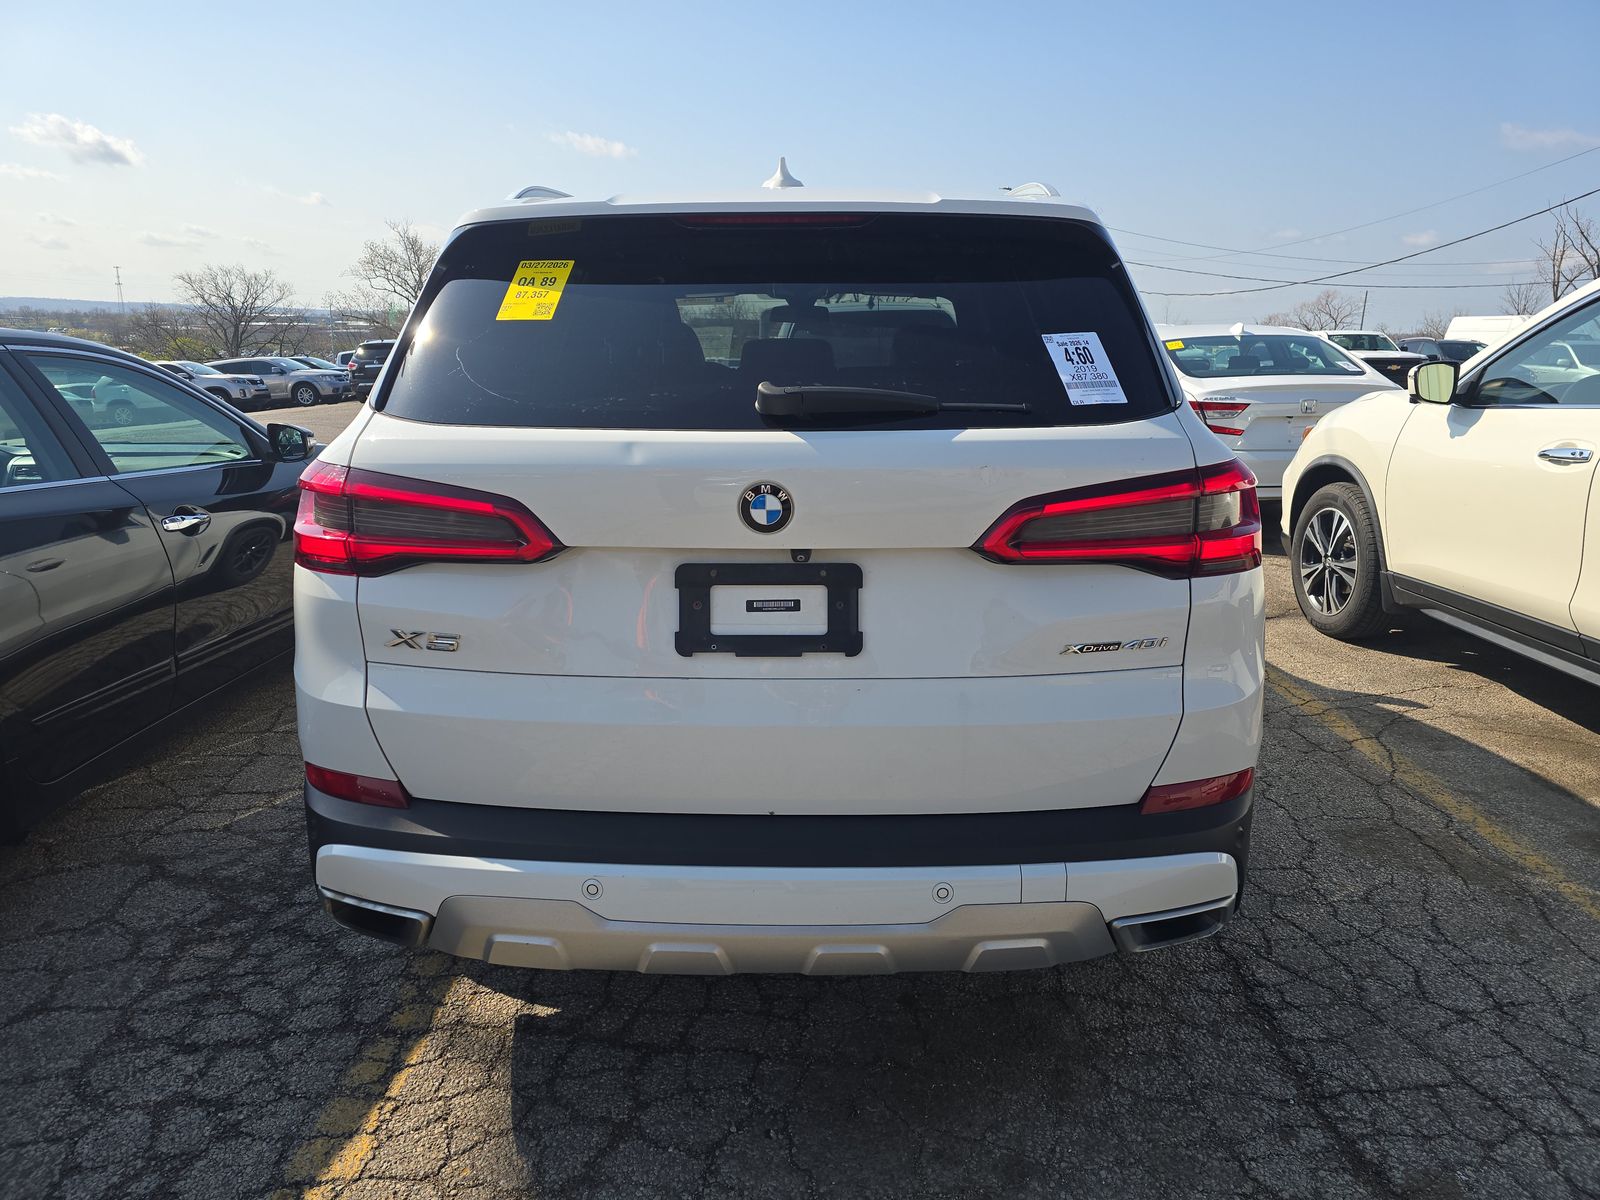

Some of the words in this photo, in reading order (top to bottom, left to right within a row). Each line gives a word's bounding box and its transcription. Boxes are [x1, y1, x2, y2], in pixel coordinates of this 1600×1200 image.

[518, 277, 536, 287] QA
[540, 276, 557, 287] 89
[1064, 346, 1095, 365] 4:60
[1073, 365, 1098, 373] 2019
[745, 485, 788, 502] BMW
[384, 628, 462, 652] X5
